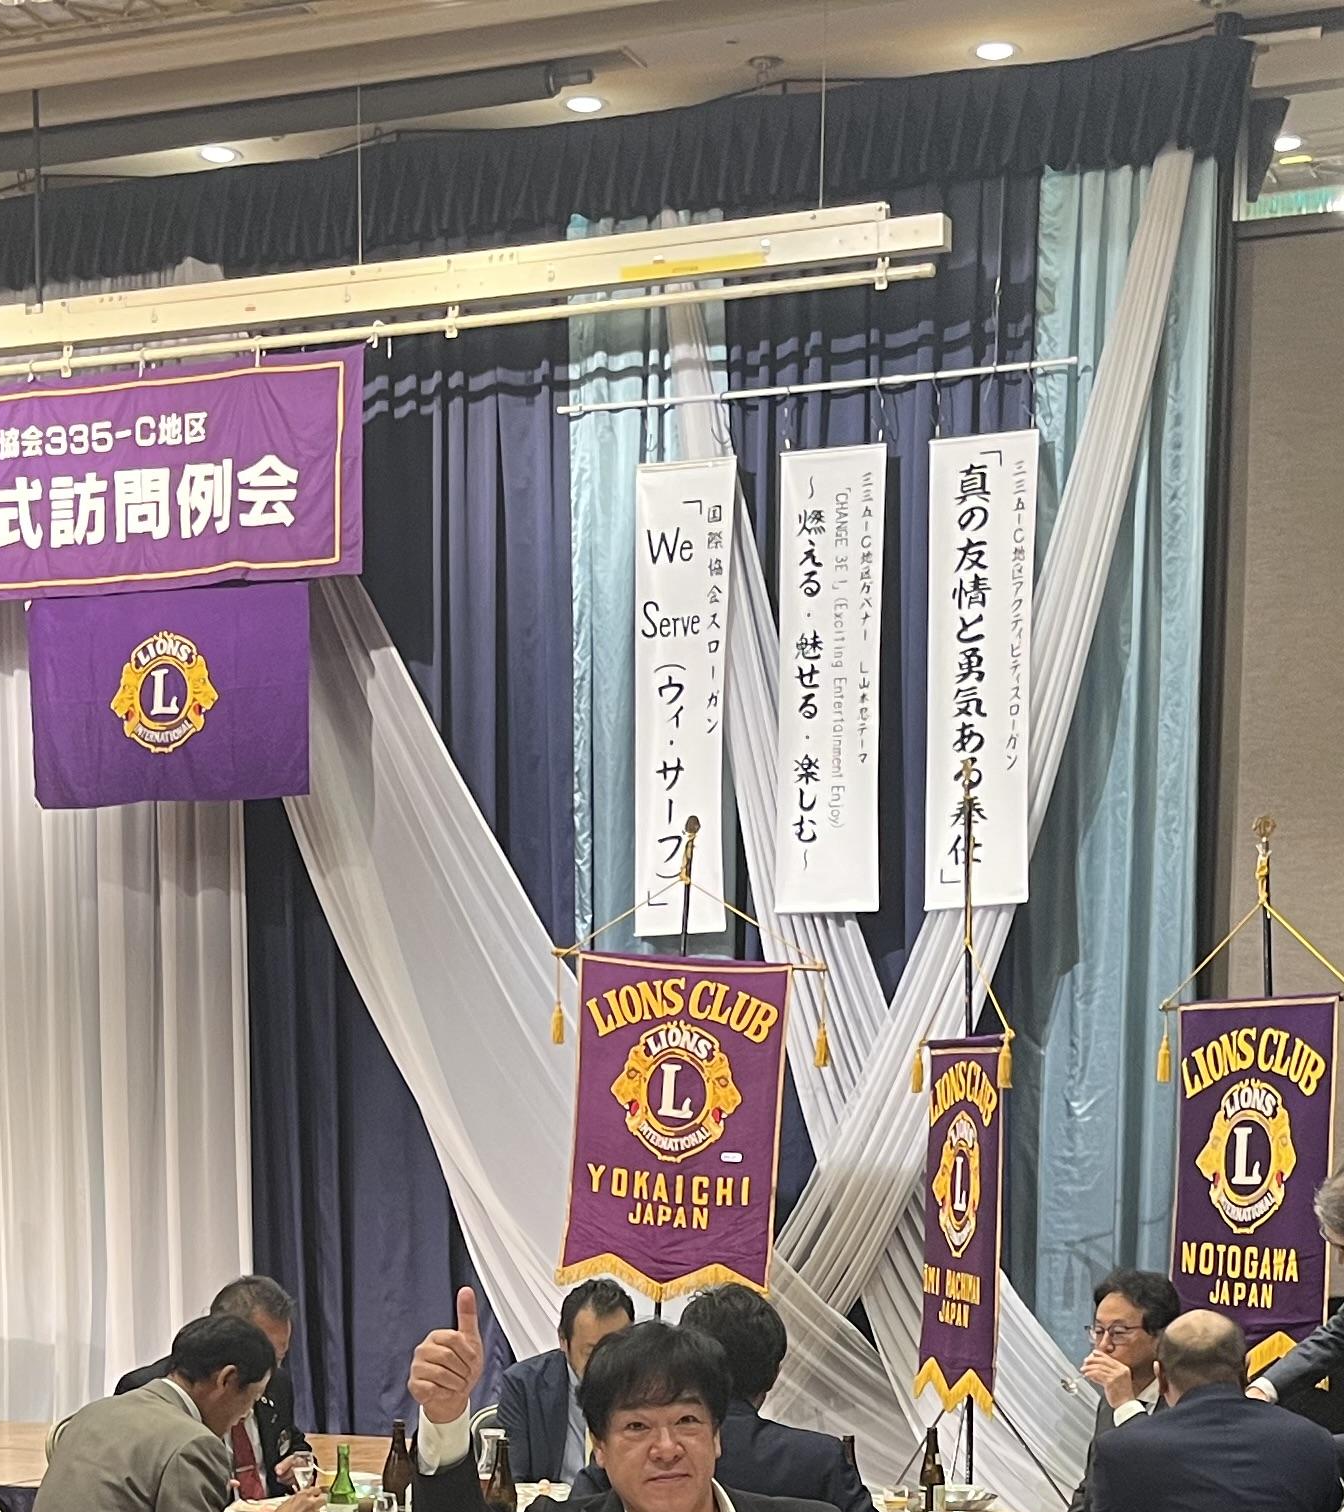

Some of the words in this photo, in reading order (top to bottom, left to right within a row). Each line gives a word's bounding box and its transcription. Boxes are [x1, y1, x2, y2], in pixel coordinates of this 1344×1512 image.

[641, 600, 701, 639] Serve
[706, 504, 724, 734] 国際協会スローガン
[136, 638, 192, 665] LIONS
[150, 668, 180, 716] L
[831, 676, 848, 779] Entertainment
[586, 977, 686, 1037] LIONS
[688, 980, 779, 1044] CLUB
[646, 1027, 713, 1060] LIONS
[1181, 1027, 1257, 1099] LIONS
[1257, 1027, 1326, 1097] CLUB
[658, 1063, 694, 1119] L
[930, 1060, 968, 1127] LIONS
[966, 1060, 998, 1127] CLUB
[1224, 1086, 1277, 1118] LIONS
[639, 1121, 713, 1151] INTERNATIONAL
[1231, 1126, 1262, 1185] L
[587, 1162, 750, 1206] YOKAICHI
[953, 1156, 966, 1212] L
[628, 1202, 709, 1230] JAPAN
[1181, 1241, 1299, 1282] NOTOGAWA
[938, 1299, 970, 1329] JAPAN
[1209, 1278, 1273, 1309] JAPAN
